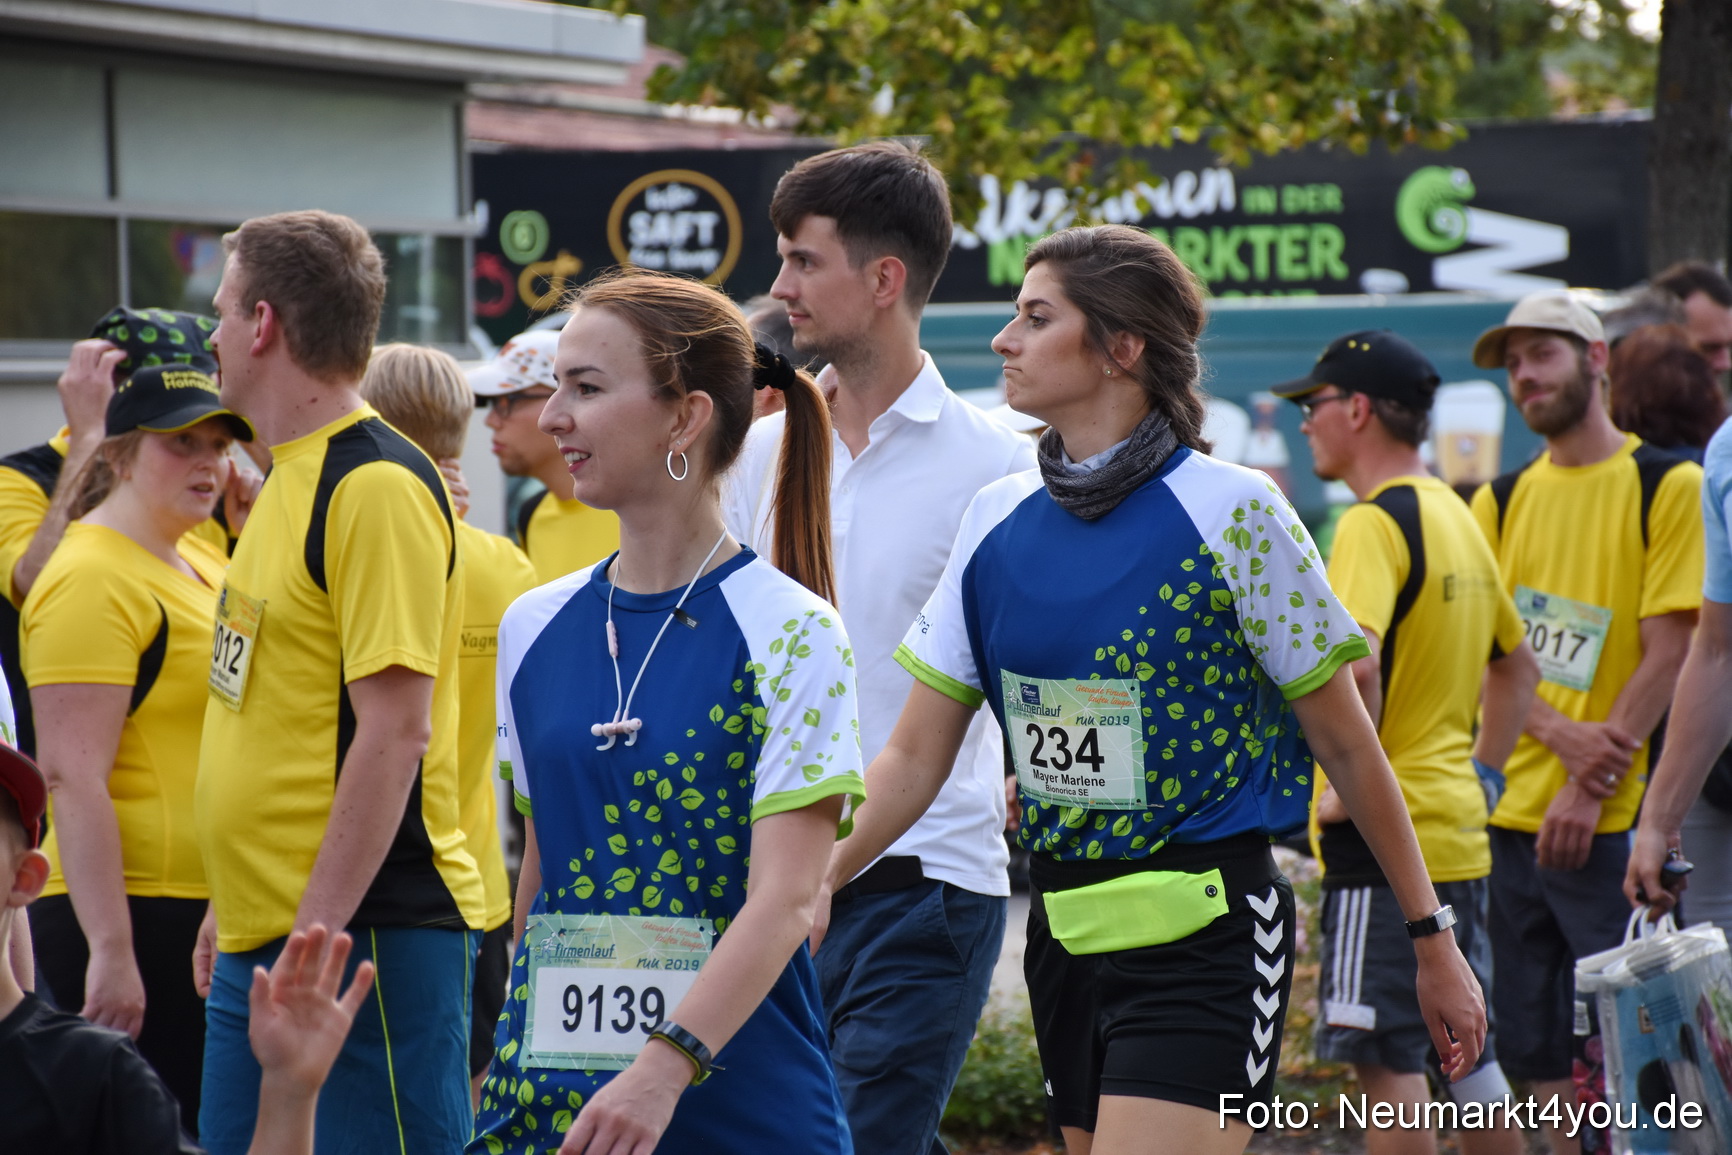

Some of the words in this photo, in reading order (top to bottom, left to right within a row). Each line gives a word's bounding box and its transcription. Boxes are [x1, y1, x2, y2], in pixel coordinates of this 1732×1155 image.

[1242, 185, 1277, 214] IN
[1282, 183, 1343, 213] DER
[629, 211, 719, 247] SAFT
[1100, 716, 1130, 726] 2019
[1026, 723, 1105, 772] 234
[1033, 769, 1058, 784] Mayer
[1061, 774, 1106, 787] Marlene
[1045, 785, 1076, 796] Bionorica
[1078, 789, 1089, 797] SE
[555, 943, 616, 958] firmenlauf
[665, 959, 699, 971] 2019
[562, 984, 665, 1035] 9139
